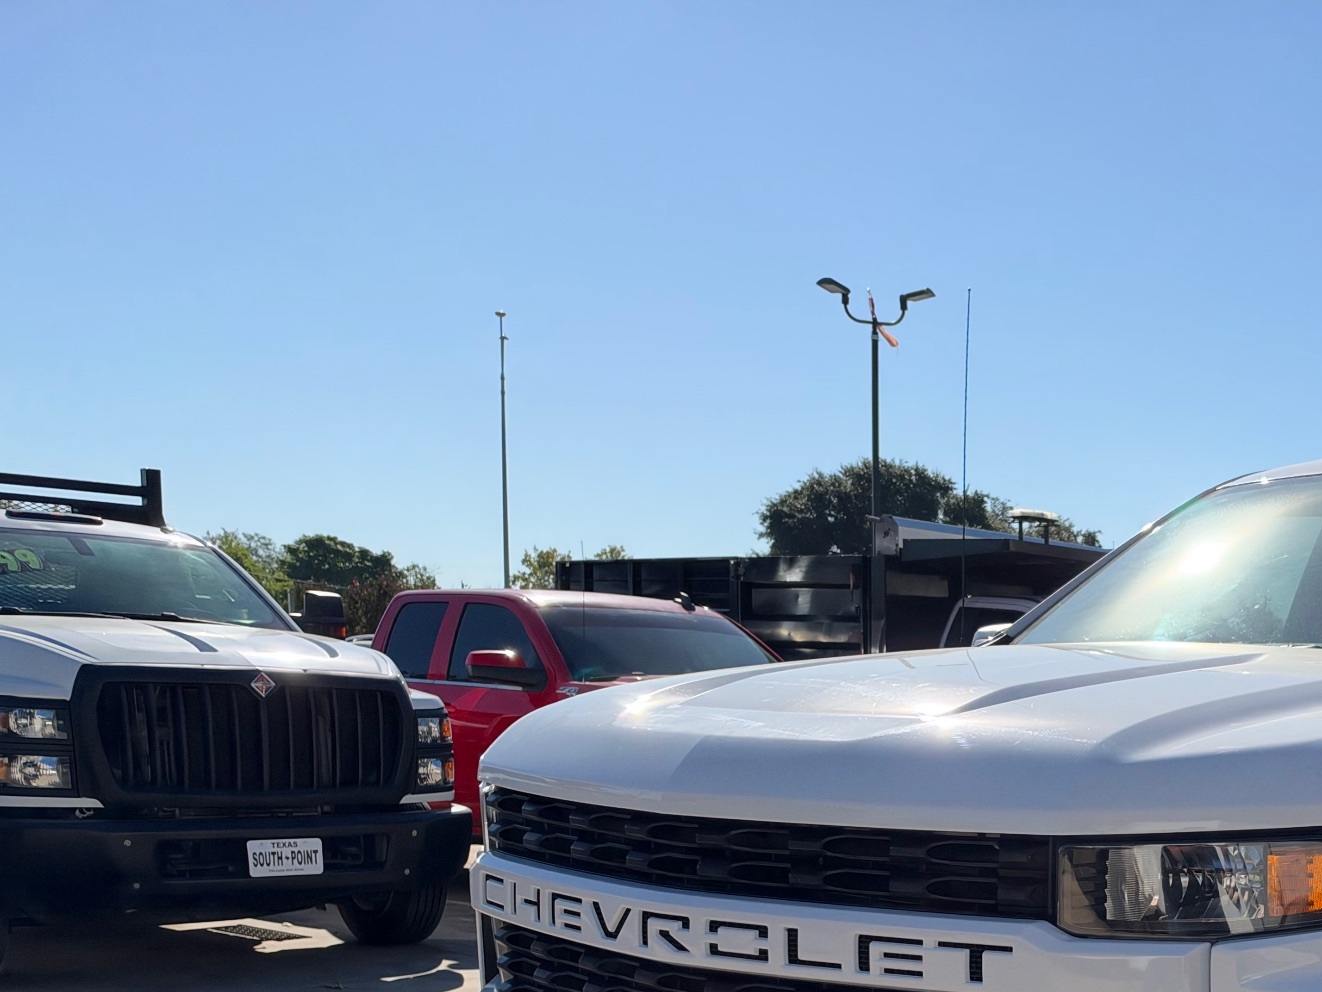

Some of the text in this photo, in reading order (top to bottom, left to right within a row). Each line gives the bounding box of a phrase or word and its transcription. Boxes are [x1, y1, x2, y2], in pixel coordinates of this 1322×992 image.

[271, 841, 298, 849] TEXAS
[252, 849, 319, 867] SOUTH POINT
[484, 872, 1014, 985] CHEVROLET
